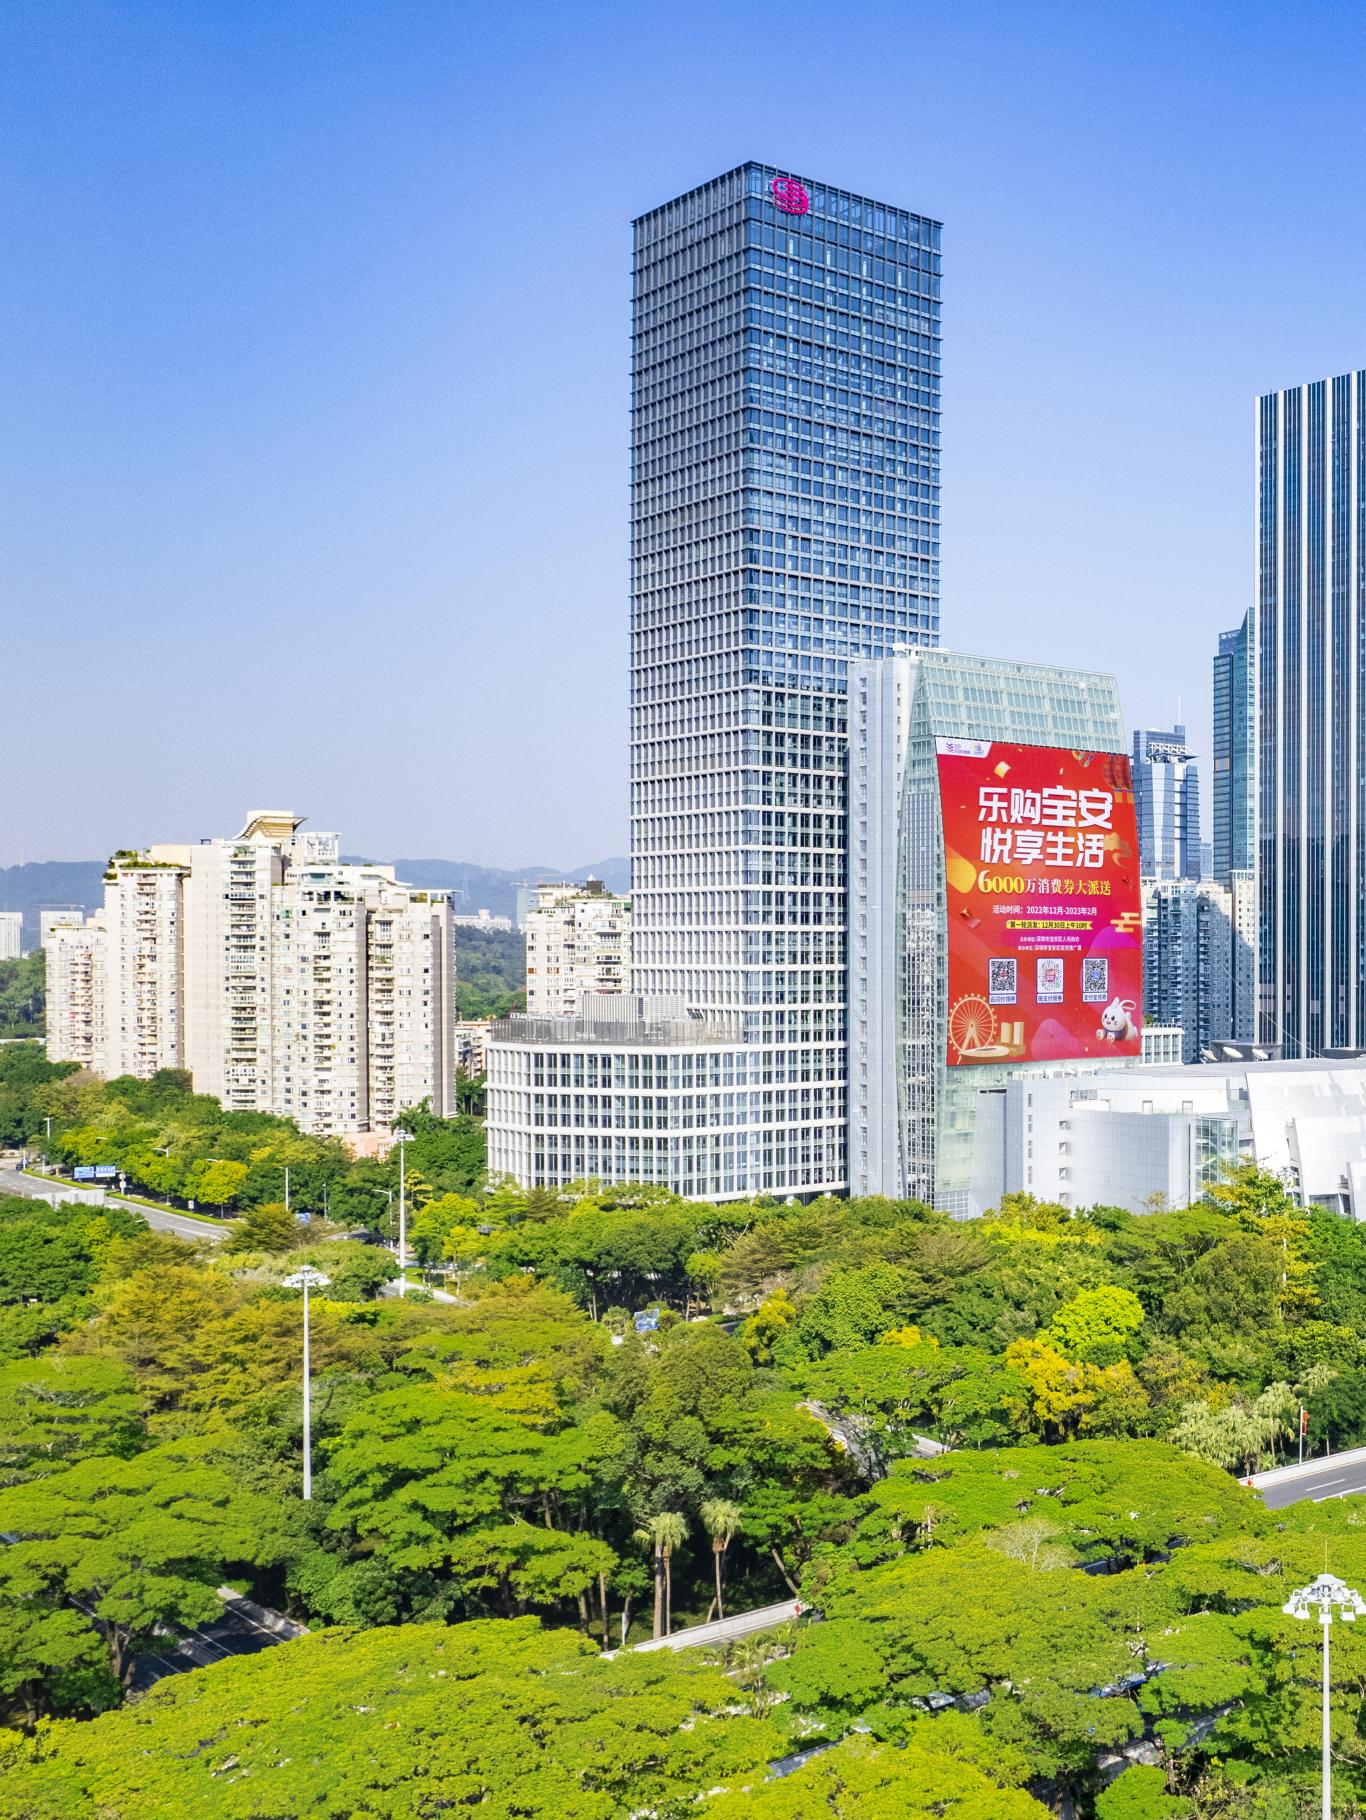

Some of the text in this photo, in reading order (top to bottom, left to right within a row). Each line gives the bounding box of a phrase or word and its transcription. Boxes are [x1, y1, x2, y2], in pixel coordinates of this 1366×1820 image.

[978, 785, 1113, 829] 乐购宝安
[980, 827, 1104, 868] 悦享生活
[978, 869, 1111, 896] 6000万消费券大派送
